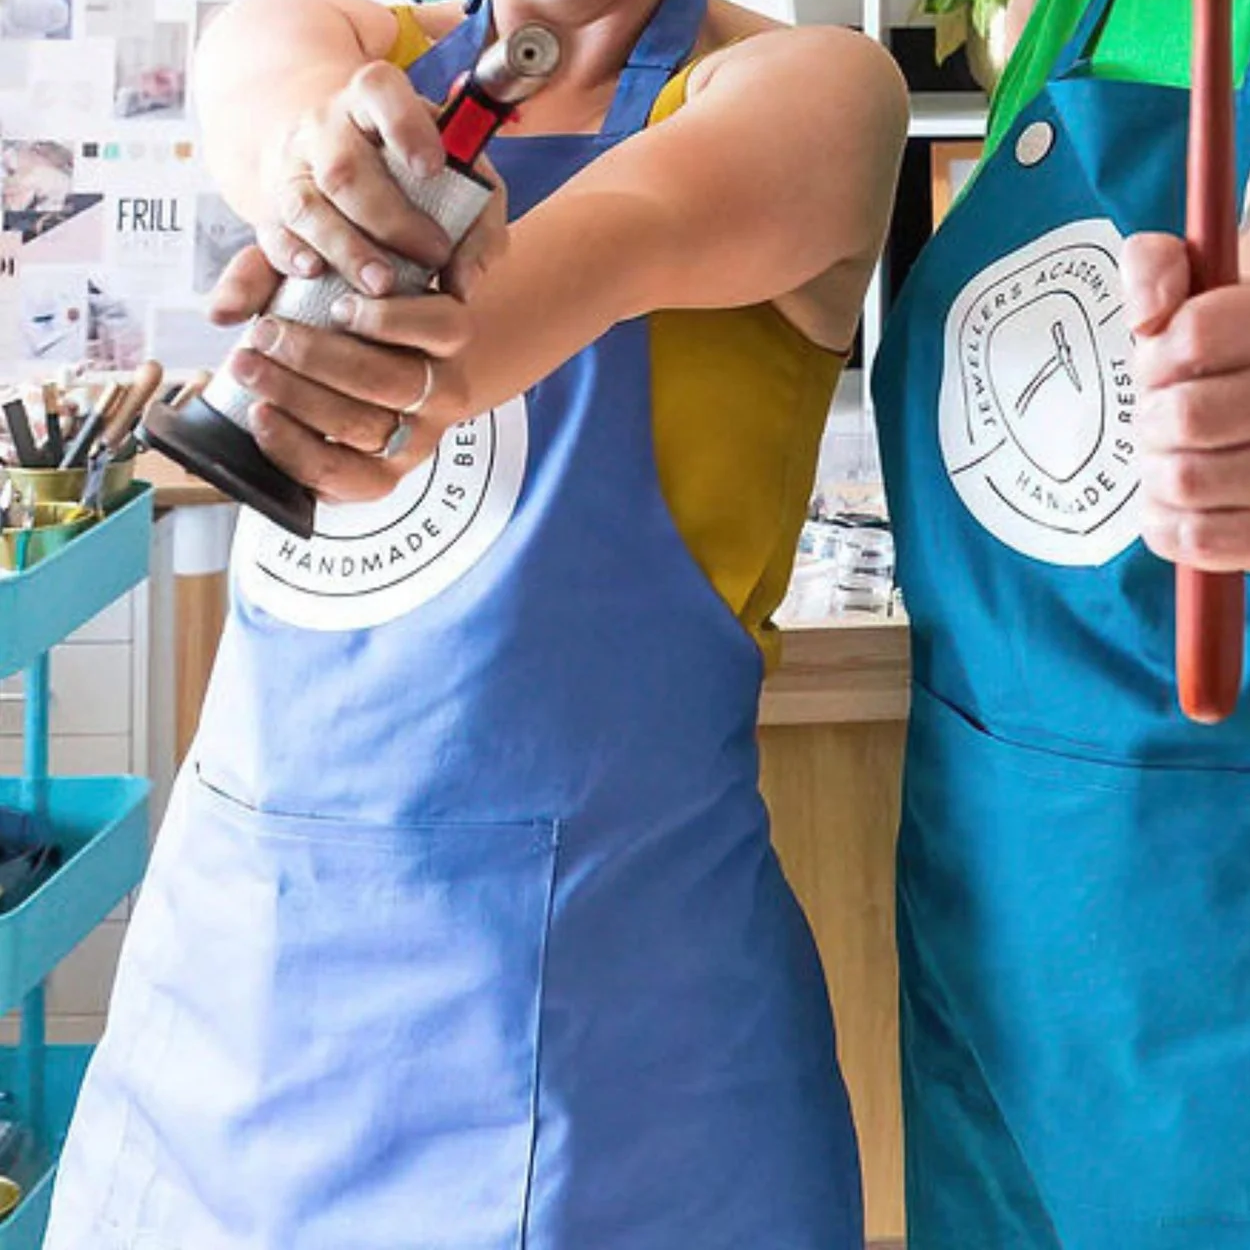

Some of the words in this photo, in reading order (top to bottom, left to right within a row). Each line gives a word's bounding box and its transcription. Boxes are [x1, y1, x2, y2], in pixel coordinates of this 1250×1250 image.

[117, 198, 183, 232] FRILL
[967, 282, 1022, 426] JEWELLERS
[1035, 261, 1111, 303] ACADEMY
[452, 418, 478, 468] BE
[441, 483, 467, 511] IS
[1015, 470, 1116, 513] HANADE
[1111, 437, 1135, 465] IS
[278, 517, 442, 578] HANDMADE
